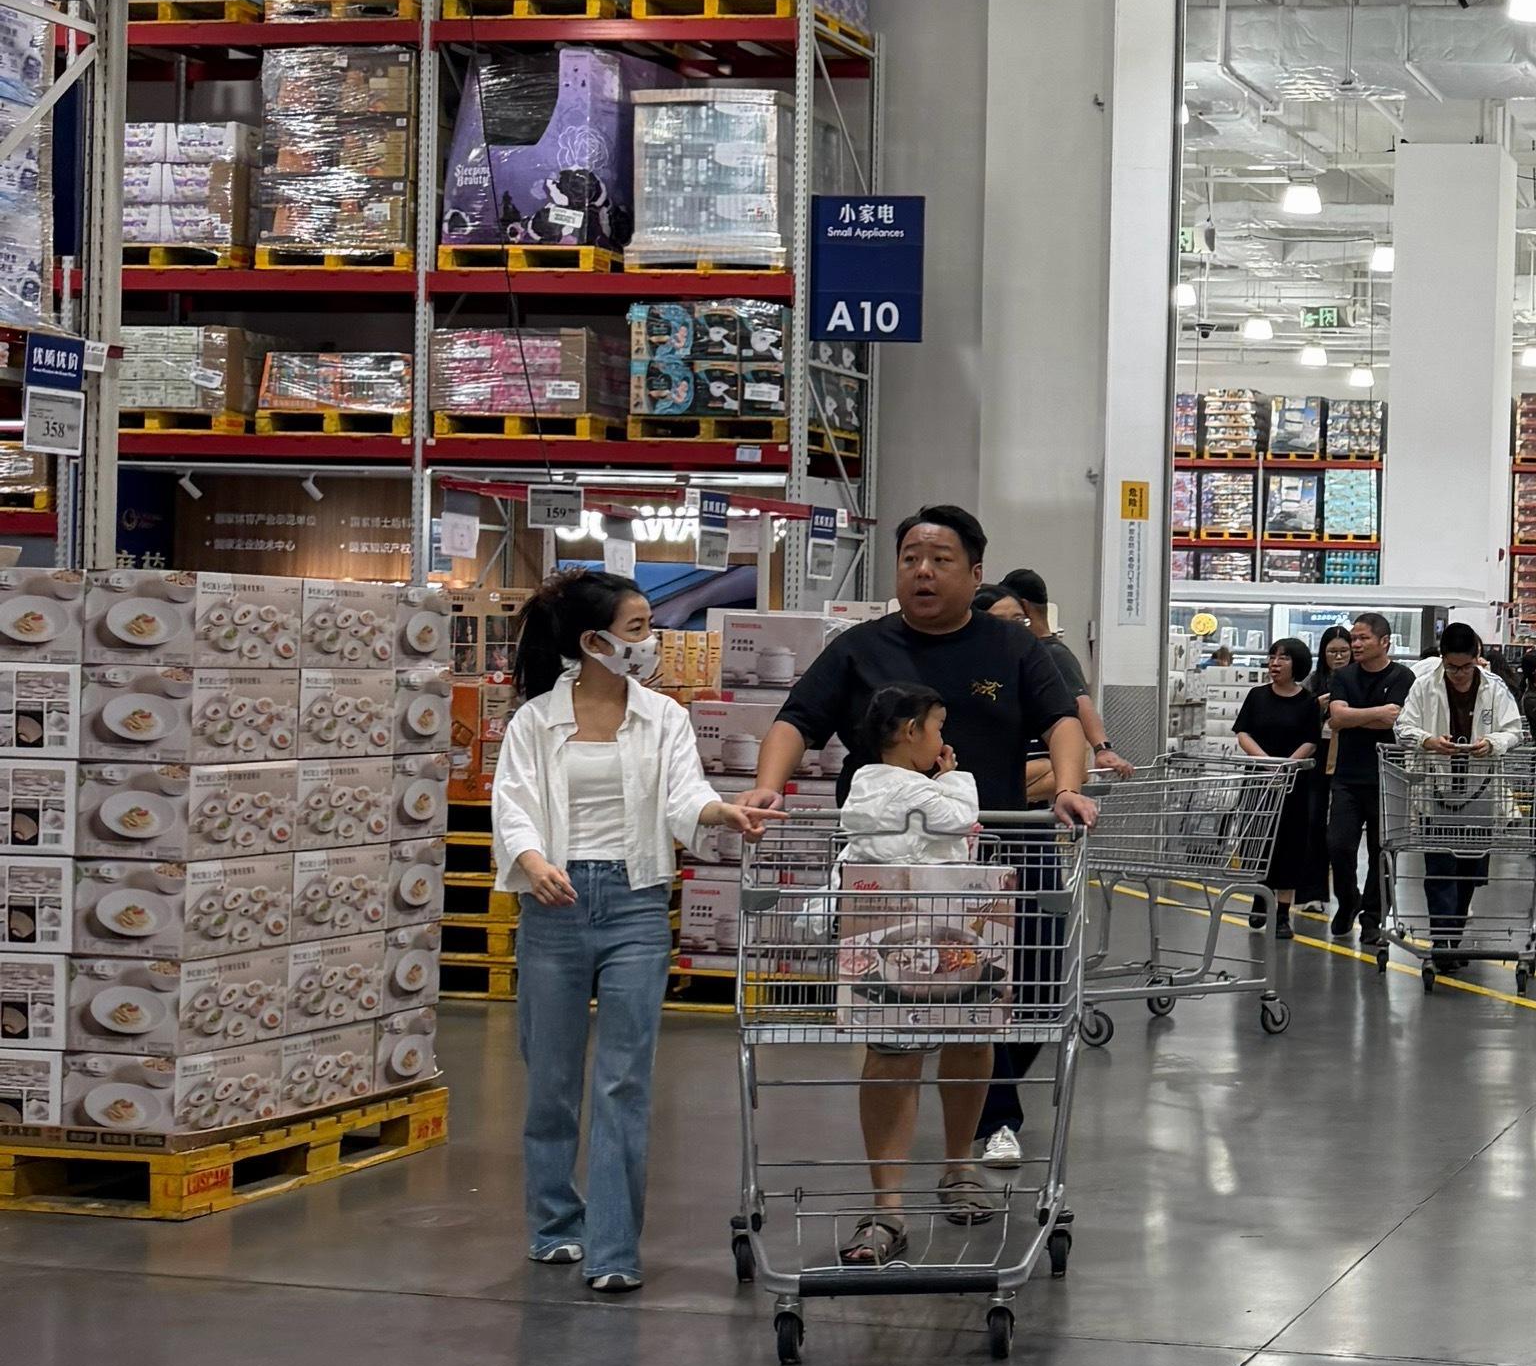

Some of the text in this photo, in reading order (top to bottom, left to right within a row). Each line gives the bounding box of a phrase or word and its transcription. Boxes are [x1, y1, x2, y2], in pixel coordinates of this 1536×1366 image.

[457, 175, 490, 187] Beauty
[838, 203, 895, 224] 小家电
[826, 226, 905, 240] Small Appliances
[825, 300, 900, 333] A10
[42, 420, 66, 438] 358
[546, 507, 567, 519] 159
